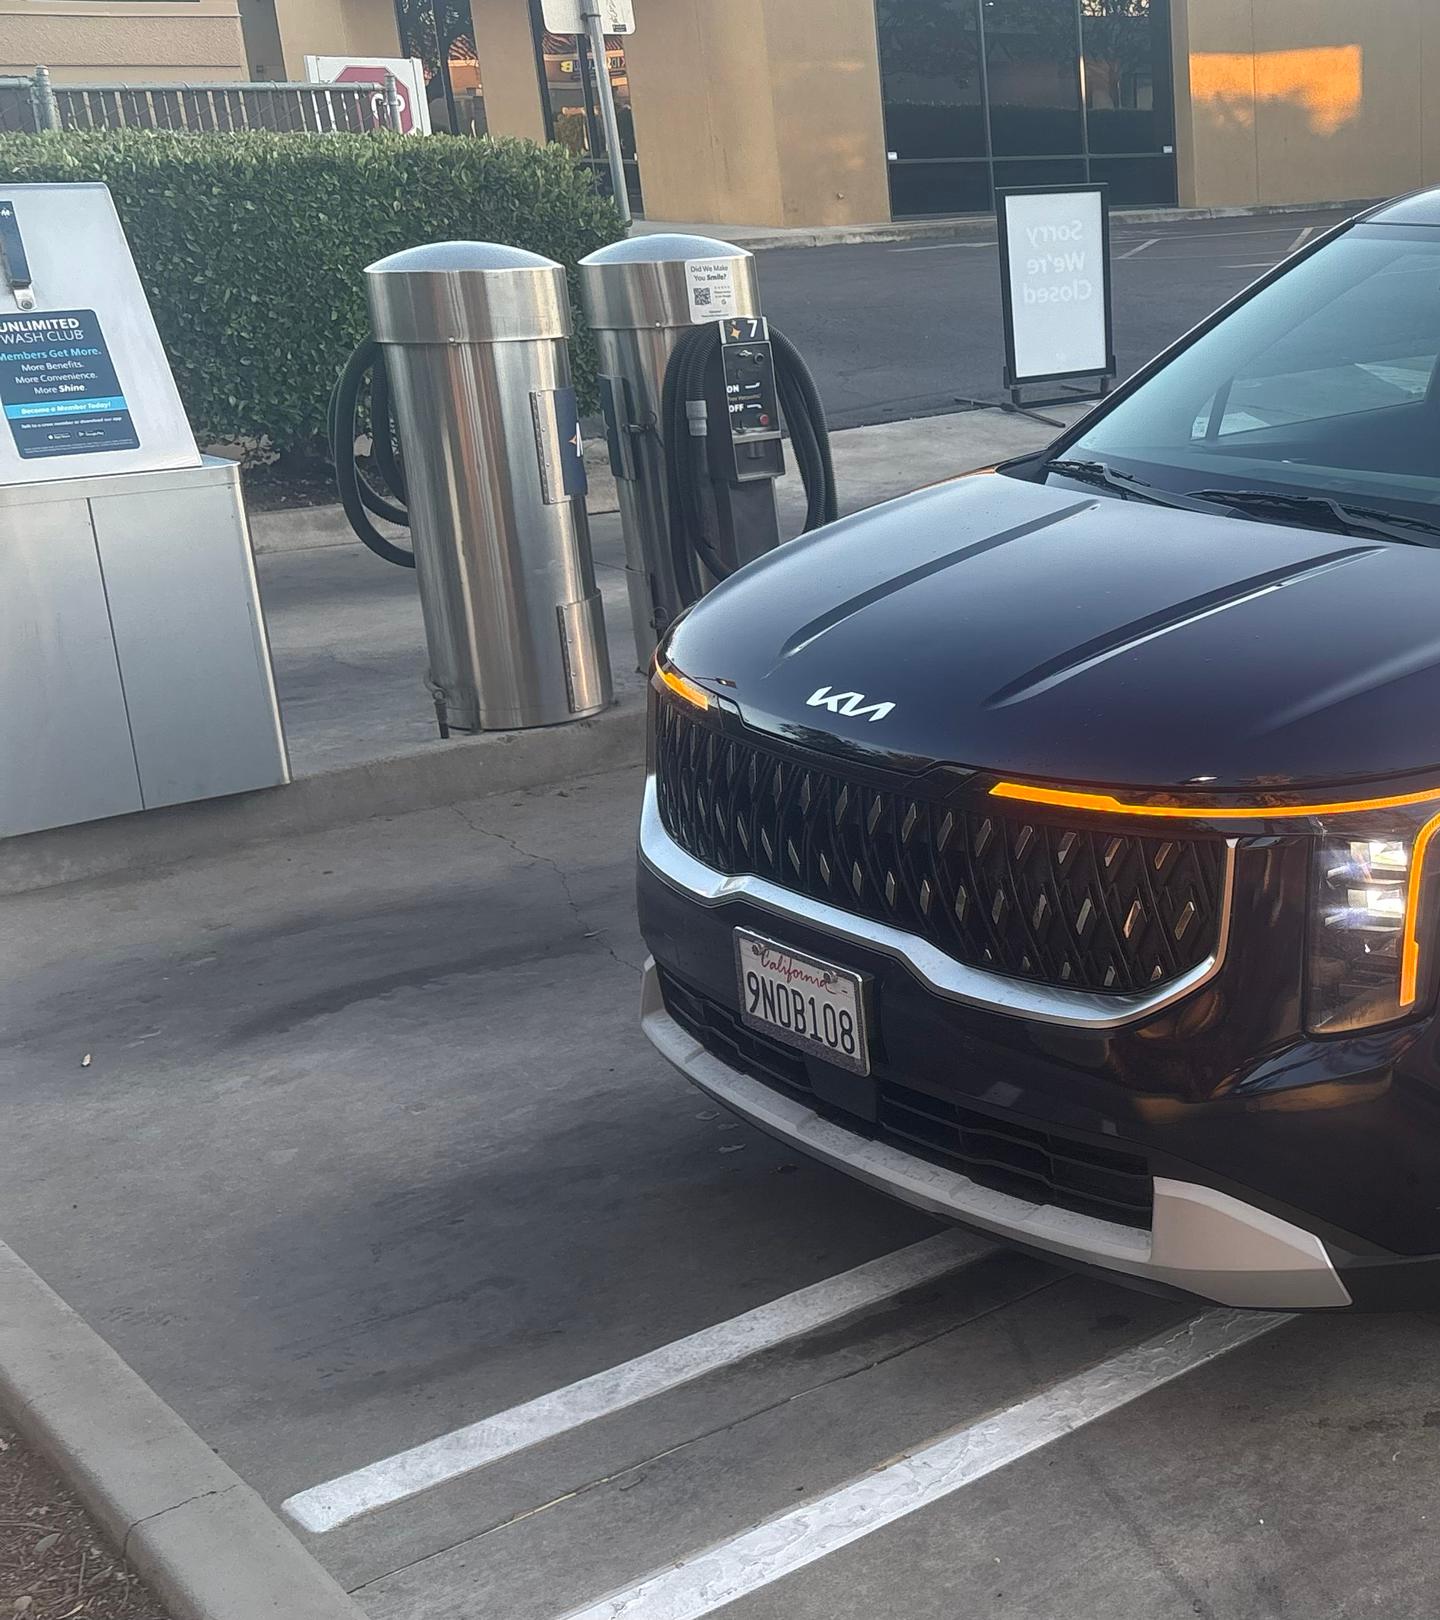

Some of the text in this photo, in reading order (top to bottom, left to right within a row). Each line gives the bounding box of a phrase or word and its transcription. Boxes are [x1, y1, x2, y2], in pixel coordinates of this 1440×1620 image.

[747, 320, 758, 338] 7
[0, 330, 83, 345] WASH CLUB
[49, 348, 68, 358] Get
[71, 348, 102, 356] More.
[21, 361, 84, 372] More Benefits.
[15, 371, 98, 384] More Convenience.
[34, 384, 88, 394] More Shine.
[726, 384, 740, 393] ON
[21, 407, 50, 415] Become
[88, 401, 111, 409] Today!
[728, 403, 744, 412] OFF
[806, 686, 896, 722] KIA
[760, 948, 837, 995] California
[747, 971, 856, 1054] 9NOB108
